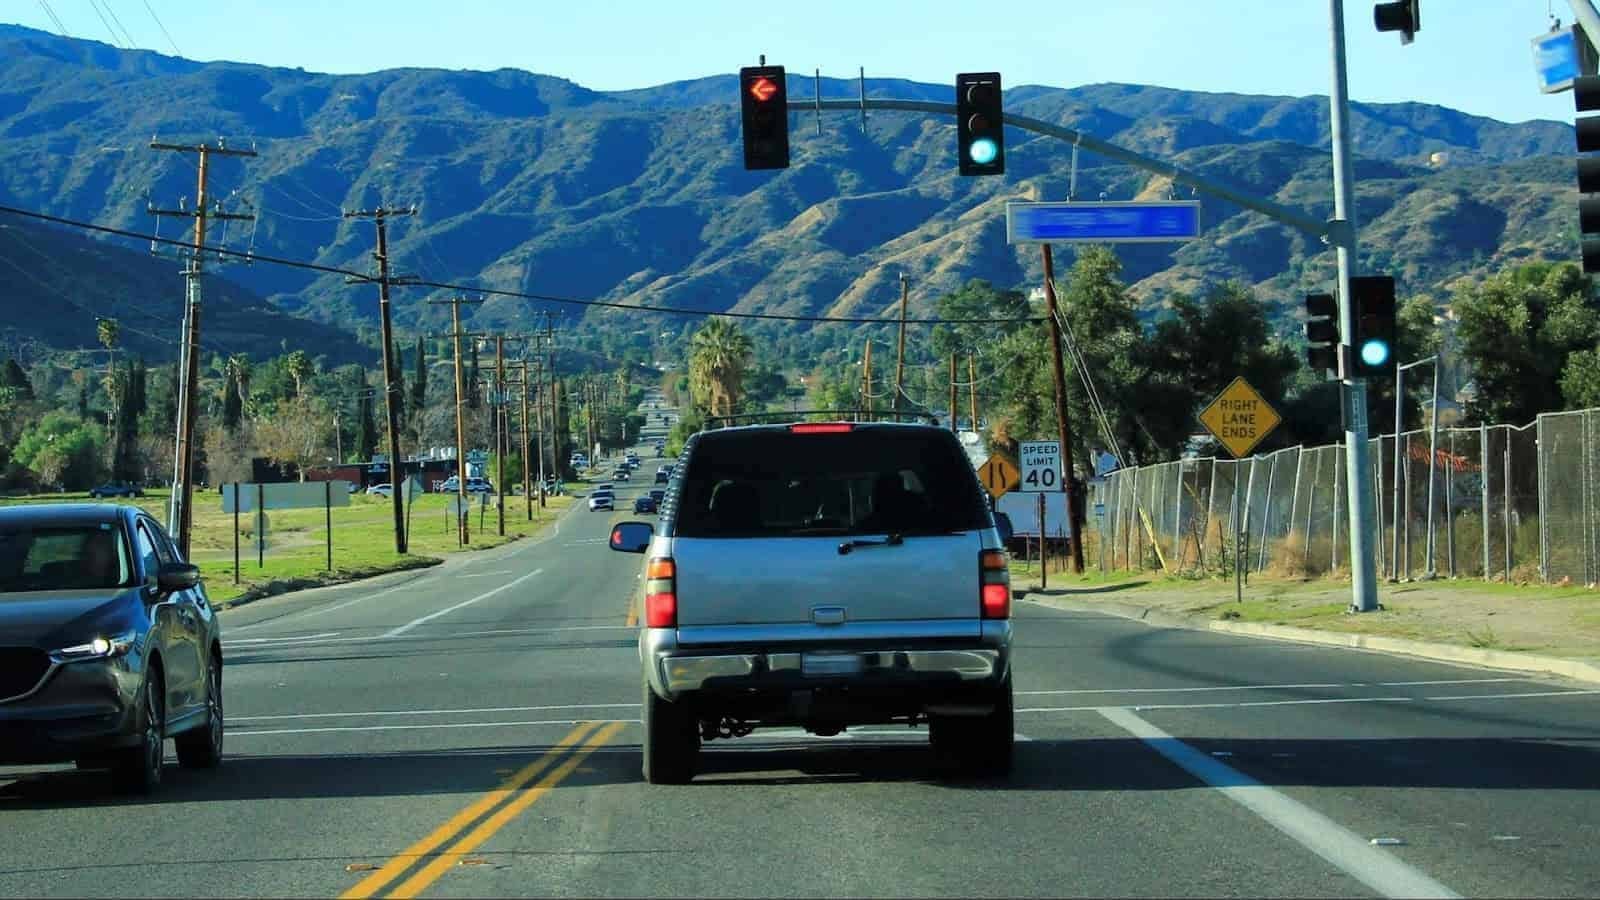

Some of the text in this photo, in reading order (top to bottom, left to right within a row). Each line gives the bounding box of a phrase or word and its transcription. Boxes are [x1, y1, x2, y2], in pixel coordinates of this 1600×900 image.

[1220, 400, 1257, 411] RIGHT
[1222, 413, 1256, 425] LANE
[1222, 427, 1257, 438] ENDS
[1023, 446, 1058, 455] SPEED
[1026, 457, 1054, 466] LIMIT
[1025, 468, 1055, 487] 40
